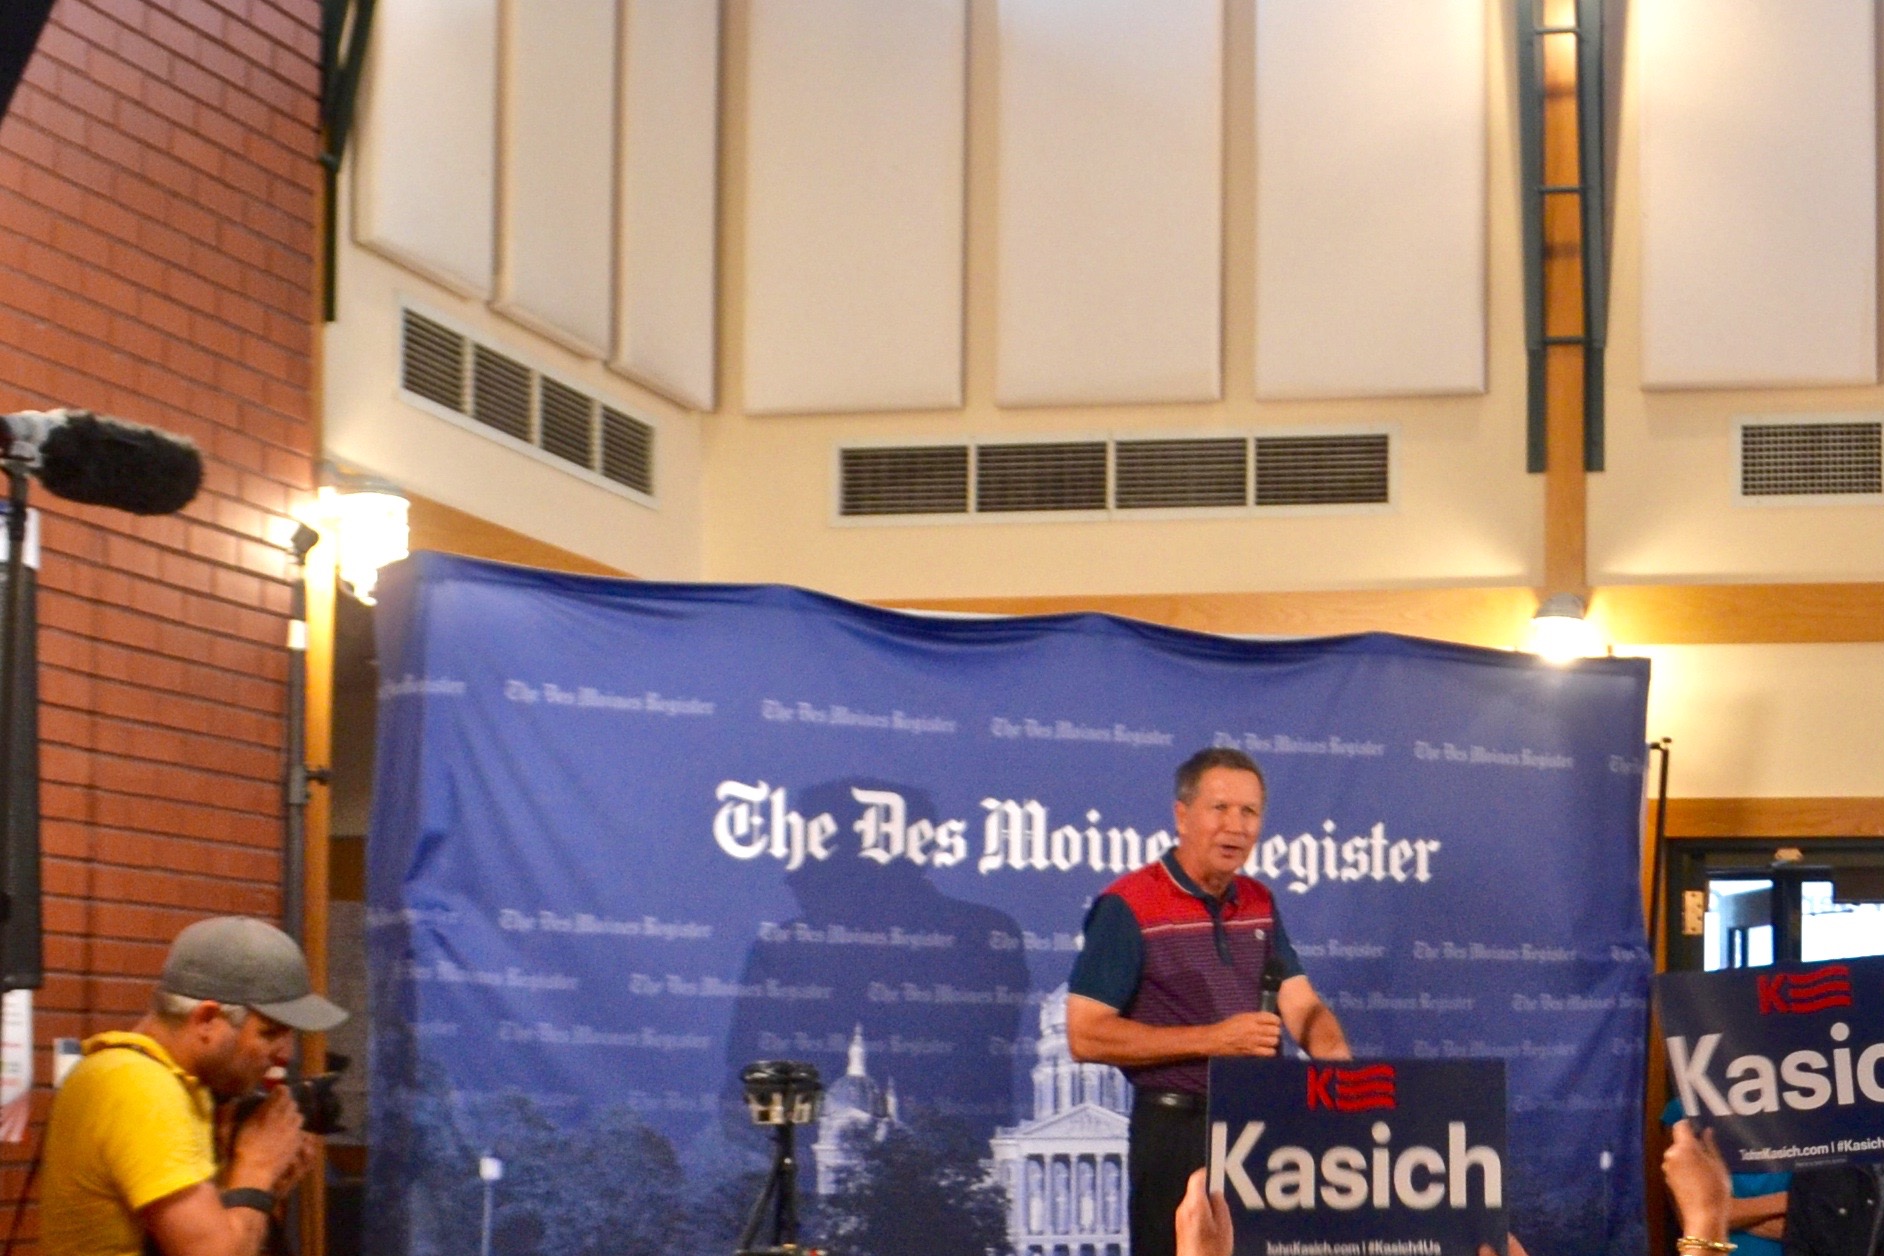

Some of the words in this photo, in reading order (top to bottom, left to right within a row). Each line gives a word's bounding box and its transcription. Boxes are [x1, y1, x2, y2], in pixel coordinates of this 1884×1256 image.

[712, 779, 838, 871] The
[850, 786, 968, 868] Des
[978, 797, 1180, 876] Moine
[1238, 818, 1441, 894] egister
[1209, 1120, 1502, 1211] Kasich
